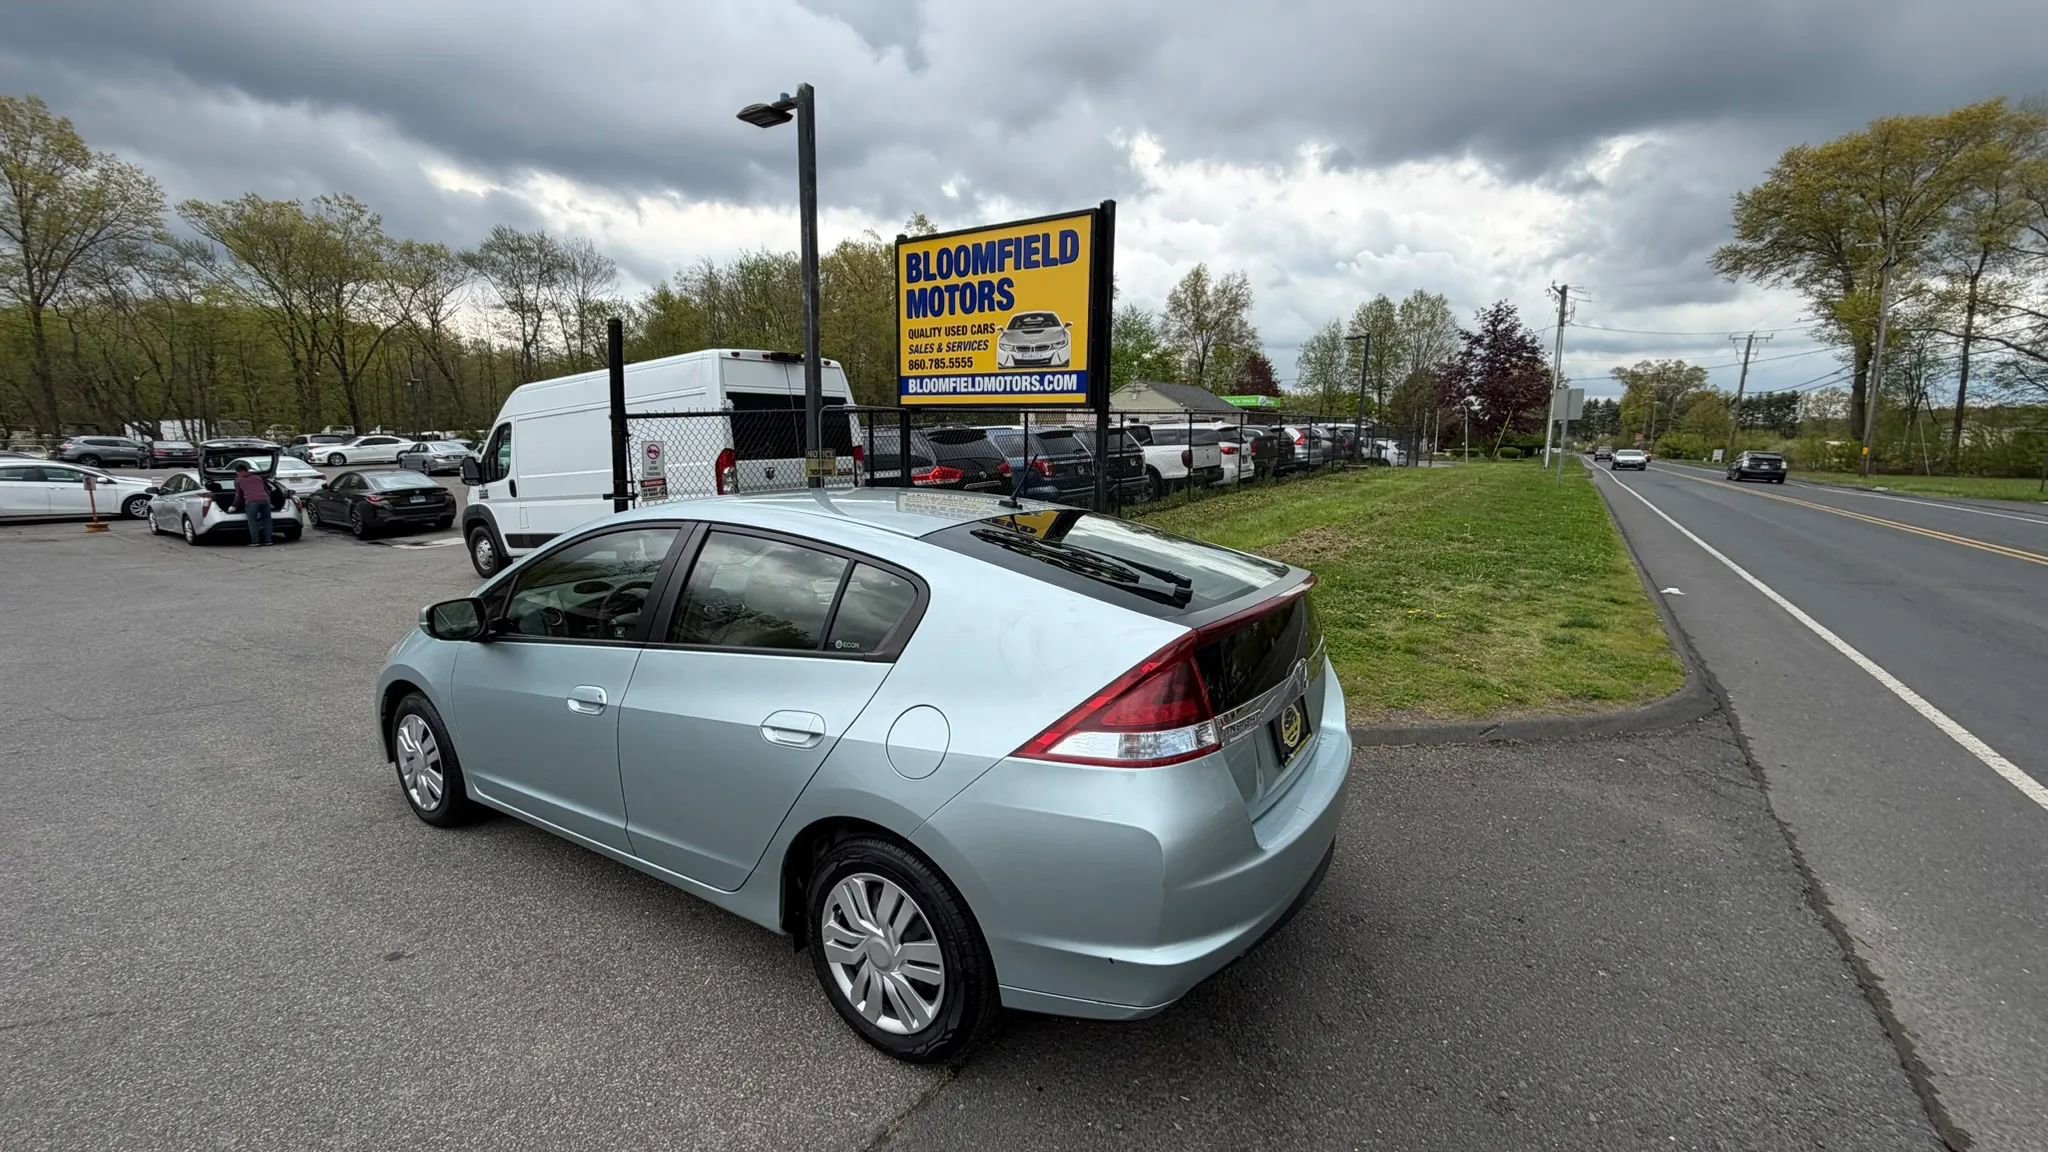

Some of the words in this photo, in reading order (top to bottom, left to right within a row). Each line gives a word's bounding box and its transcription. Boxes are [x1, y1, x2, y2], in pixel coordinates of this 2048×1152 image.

[905, 229, 1080, 284] BLOOMFIELD
[905, 277, 1015, 320] MOTORS
[908, 327, 942, 340] QUALITY
[945, 325, 968, 337] USED
[971, 323, 996, 335] CARS
[908, 343, 935, 355] SALES
[937, 343, 943, 353] &
[946, 339, 990, 353] SERVICES
[908, 357, 973, 371] 860.785.5555
[908, 374, 1077, 394] BLOOMFIELDMOTORS.COM
[807, 450, 834, 458] NOICE
